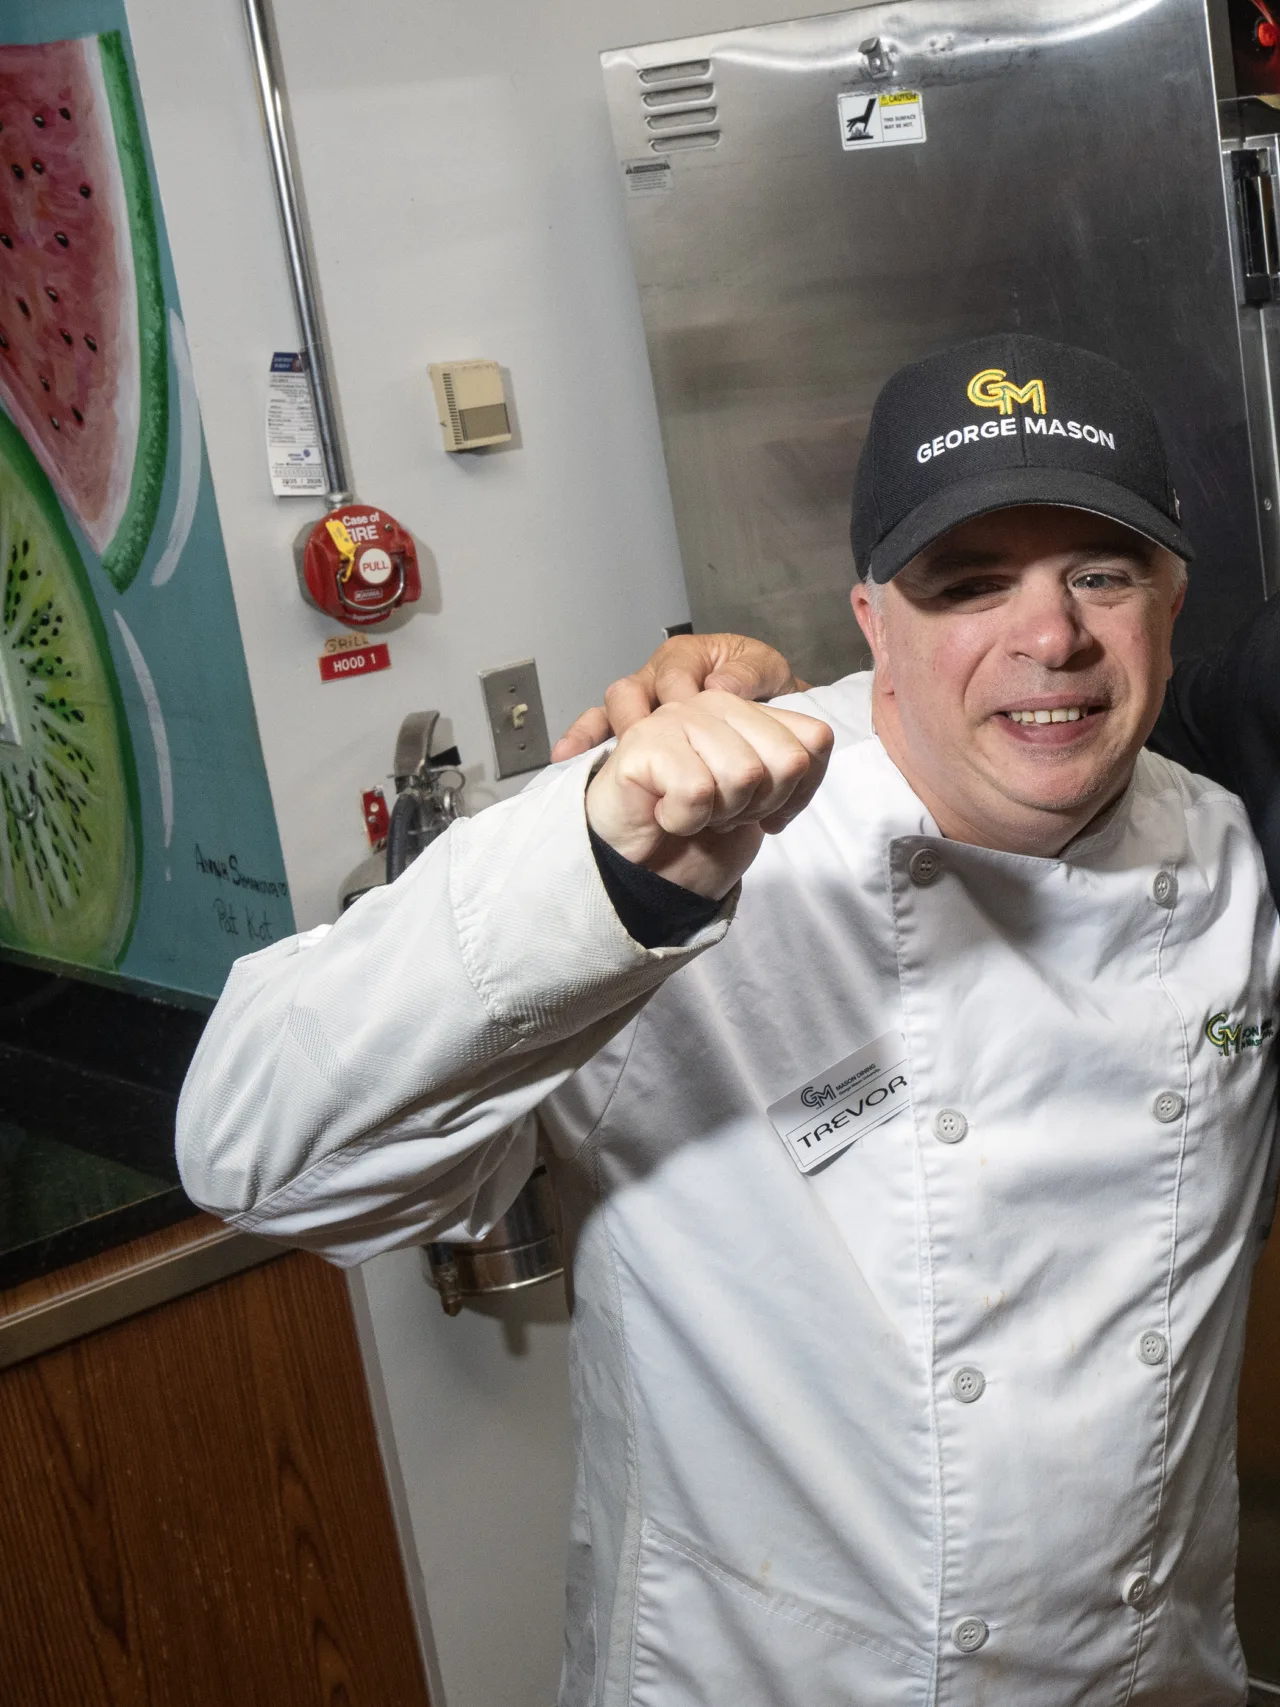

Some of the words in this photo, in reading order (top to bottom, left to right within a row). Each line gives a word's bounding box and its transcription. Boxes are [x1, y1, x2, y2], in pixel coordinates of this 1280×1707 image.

[888, 93, 917, 103] CAUTION
[966, 367, 1048, 415] GM
[916, 416, 1018, 464] GEORGE
[1025, 416, 1116, 451] MASON
[342, 515, 369, 527] Case
[369, 511, 380, 523] of
[362, 562, 389, 572] PULL
[333, 655, 365, 673] HOOD
[370, 653, 376, 665] 1
[836, 1075, 857, 1091] MASON
[856, 1063, 876, 1078] DINING
[796, 1074, 908, 1148] TREVOR
